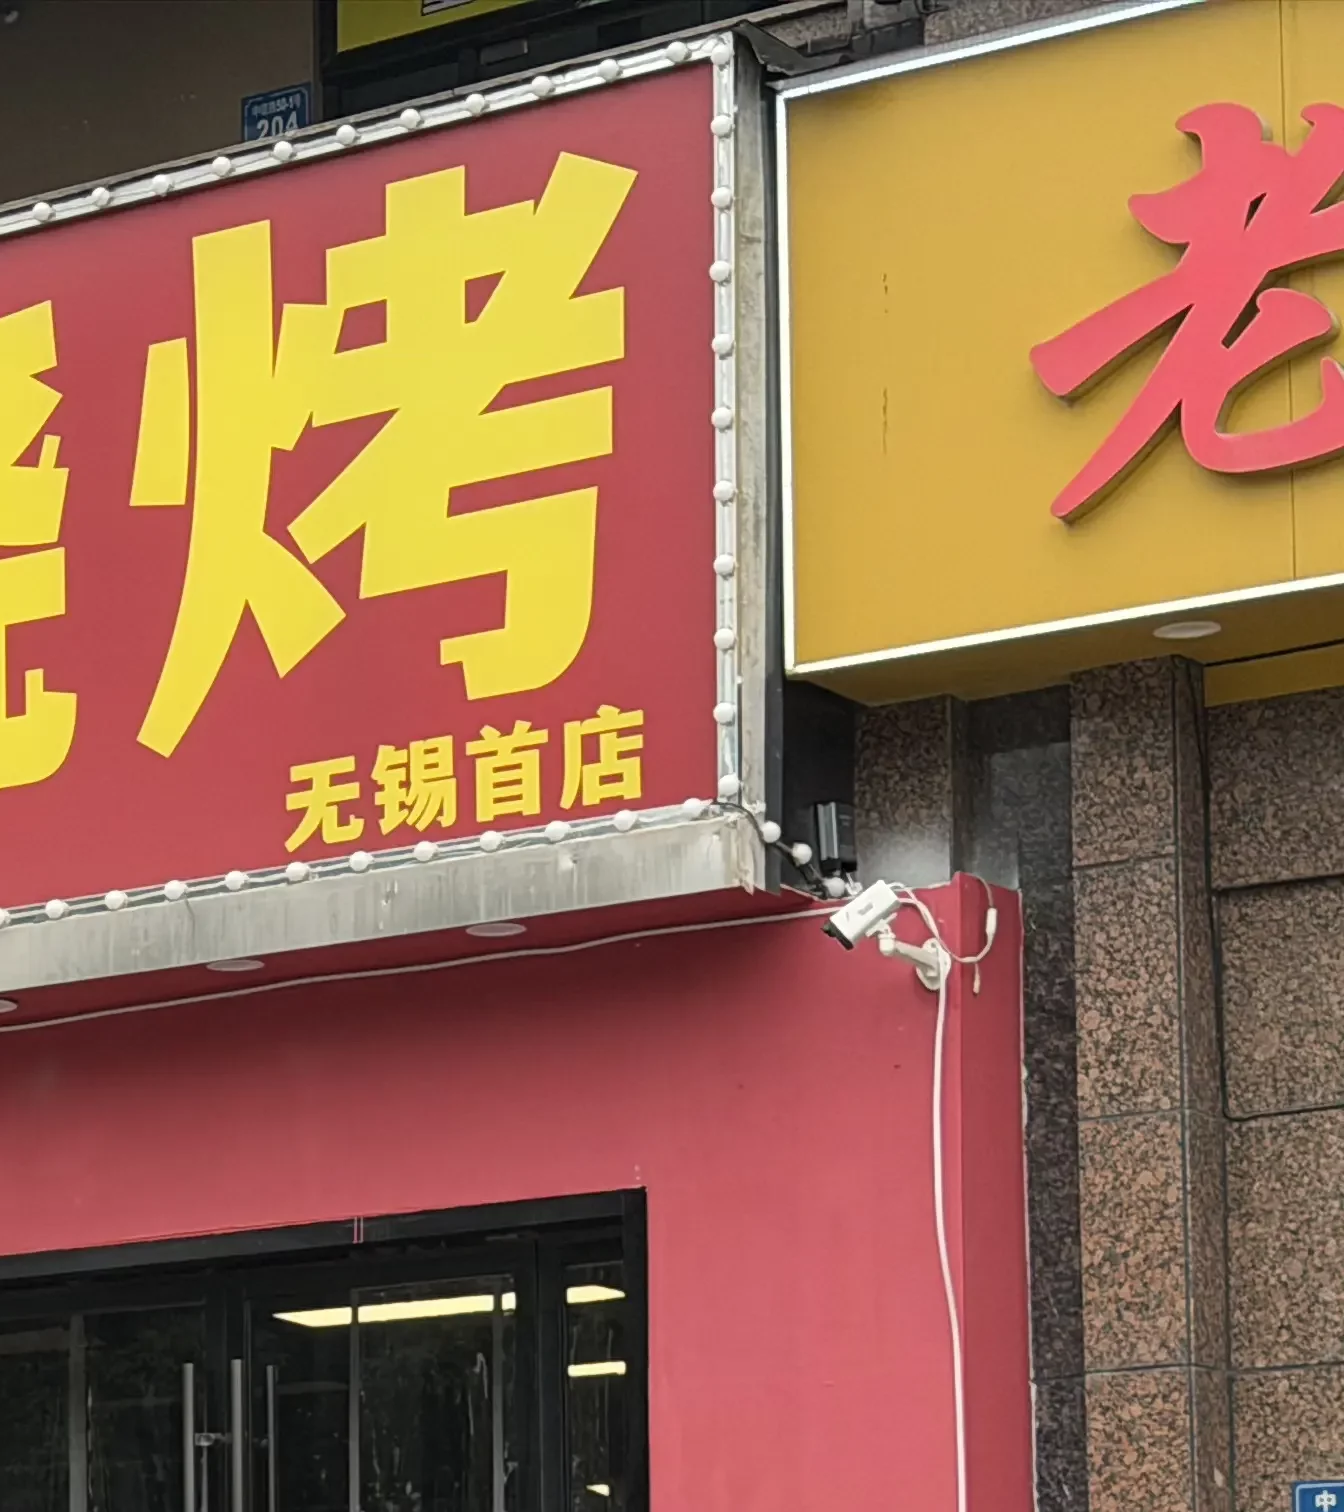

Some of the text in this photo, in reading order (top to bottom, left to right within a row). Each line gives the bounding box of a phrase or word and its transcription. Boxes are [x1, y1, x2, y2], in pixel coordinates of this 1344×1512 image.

[1029, 102, 1344, 523] 老
[284, 705, 644, 853] 无锡首店
[1315, 1489, 1337, 1512] 中
